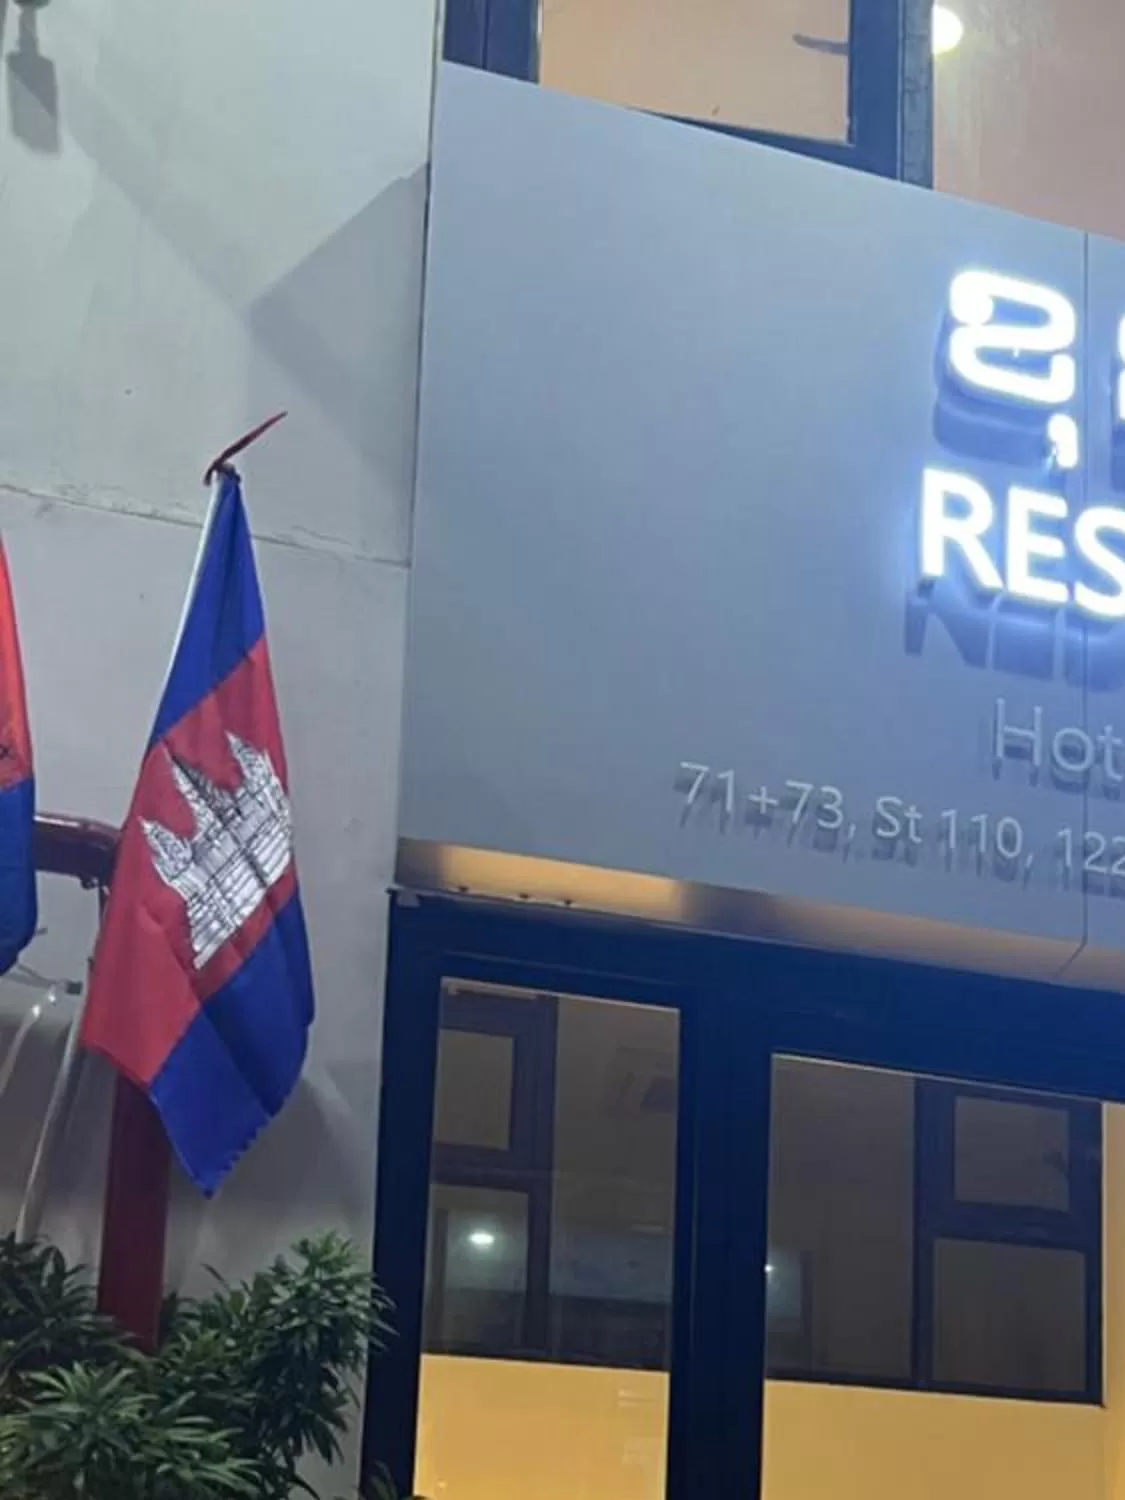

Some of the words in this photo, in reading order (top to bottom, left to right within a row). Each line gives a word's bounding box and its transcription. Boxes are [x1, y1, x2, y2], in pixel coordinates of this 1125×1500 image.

[680, 760, 857, 837] 71+73,
[876, 796, 922, 844] St
[940, 808, 1033, 866] 110,
